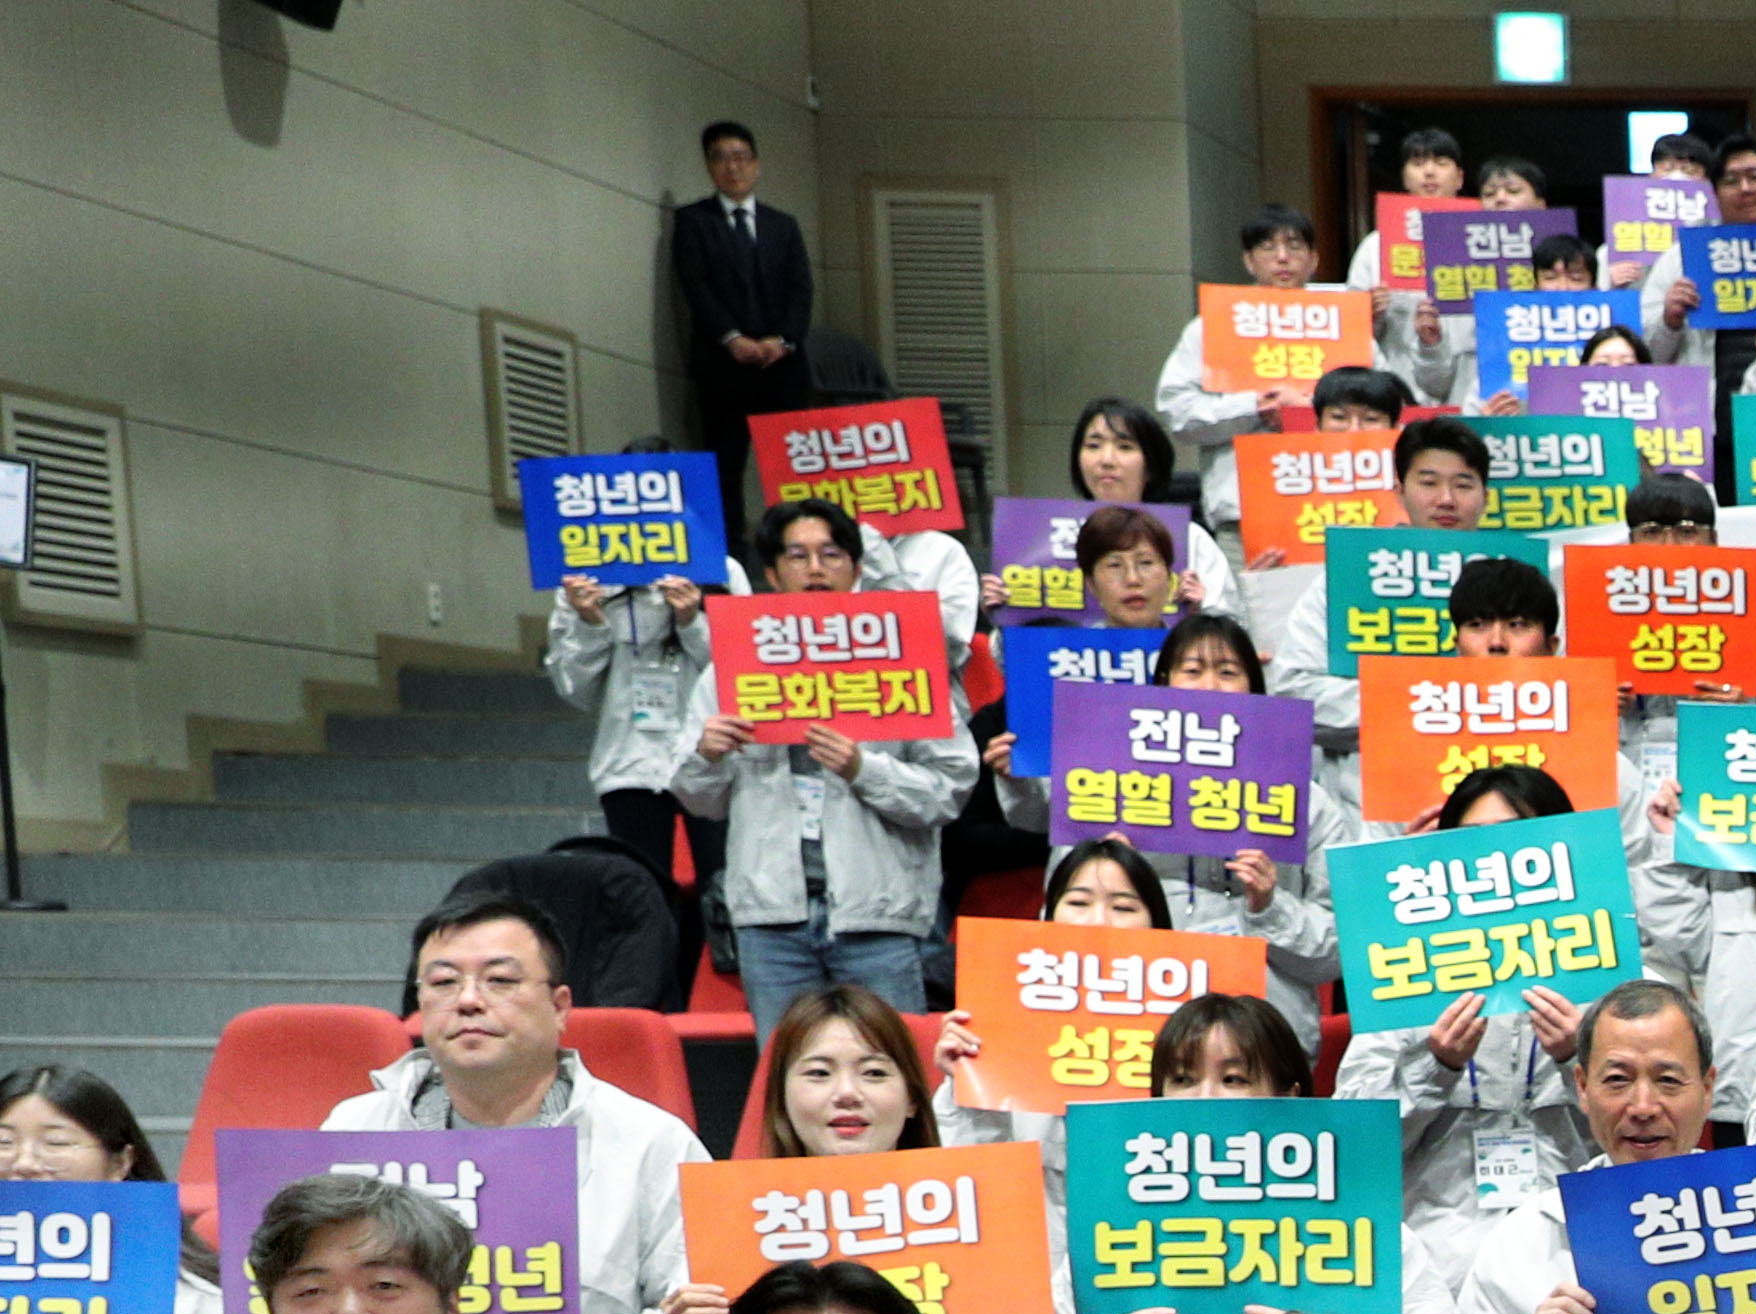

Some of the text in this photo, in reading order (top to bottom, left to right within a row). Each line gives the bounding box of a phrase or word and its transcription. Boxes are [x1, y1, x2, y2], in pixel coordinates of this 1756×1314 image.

[1645, 188, 1708, 220] 전남
[1465, 223, 1533, 258] 전남
[1613, 221, 1673, 252] 열혈
[1433, 265, 1497, 301] 열혈
[1233, 302, 1340, 338] 청년의
[1505, 305, 1612, 342] 청년의
[1253, 345, 1326, 379] 성장
[1580, 380, 1660, 420] 전남
[783, 419, 910, 474] 청년의
[552, 469, 684, 517] 청년의
[1270, 447, 1396, 496] 청년의
[559, 522, 689, 567] 일자리
[1001, 564, 1085, 610] 열혈
[1604, 566, 1746, 615] 청년의
[751, 610, 902, 665] 청년의
[1628, 623, 1727, 673] 성장
[735, 667, 934, 722] 문화복지
[1408, 679, 1570, 734] 청년의
[1128, 707, 1241, 767] 전남
[1064, 768, 1297, 836] 열혈 청년
[1385, 840, 1576, 926] 청년의
[1367, 907, 1619, 1003] 보금자리
[1016, 949, 1209, 1015] 청년의
[1123, 1130, 1337, 1205] 청년의
[752, 1173, 981, 1265] 청년의
[1091, 1216, 1376, 1289] 보금자리
